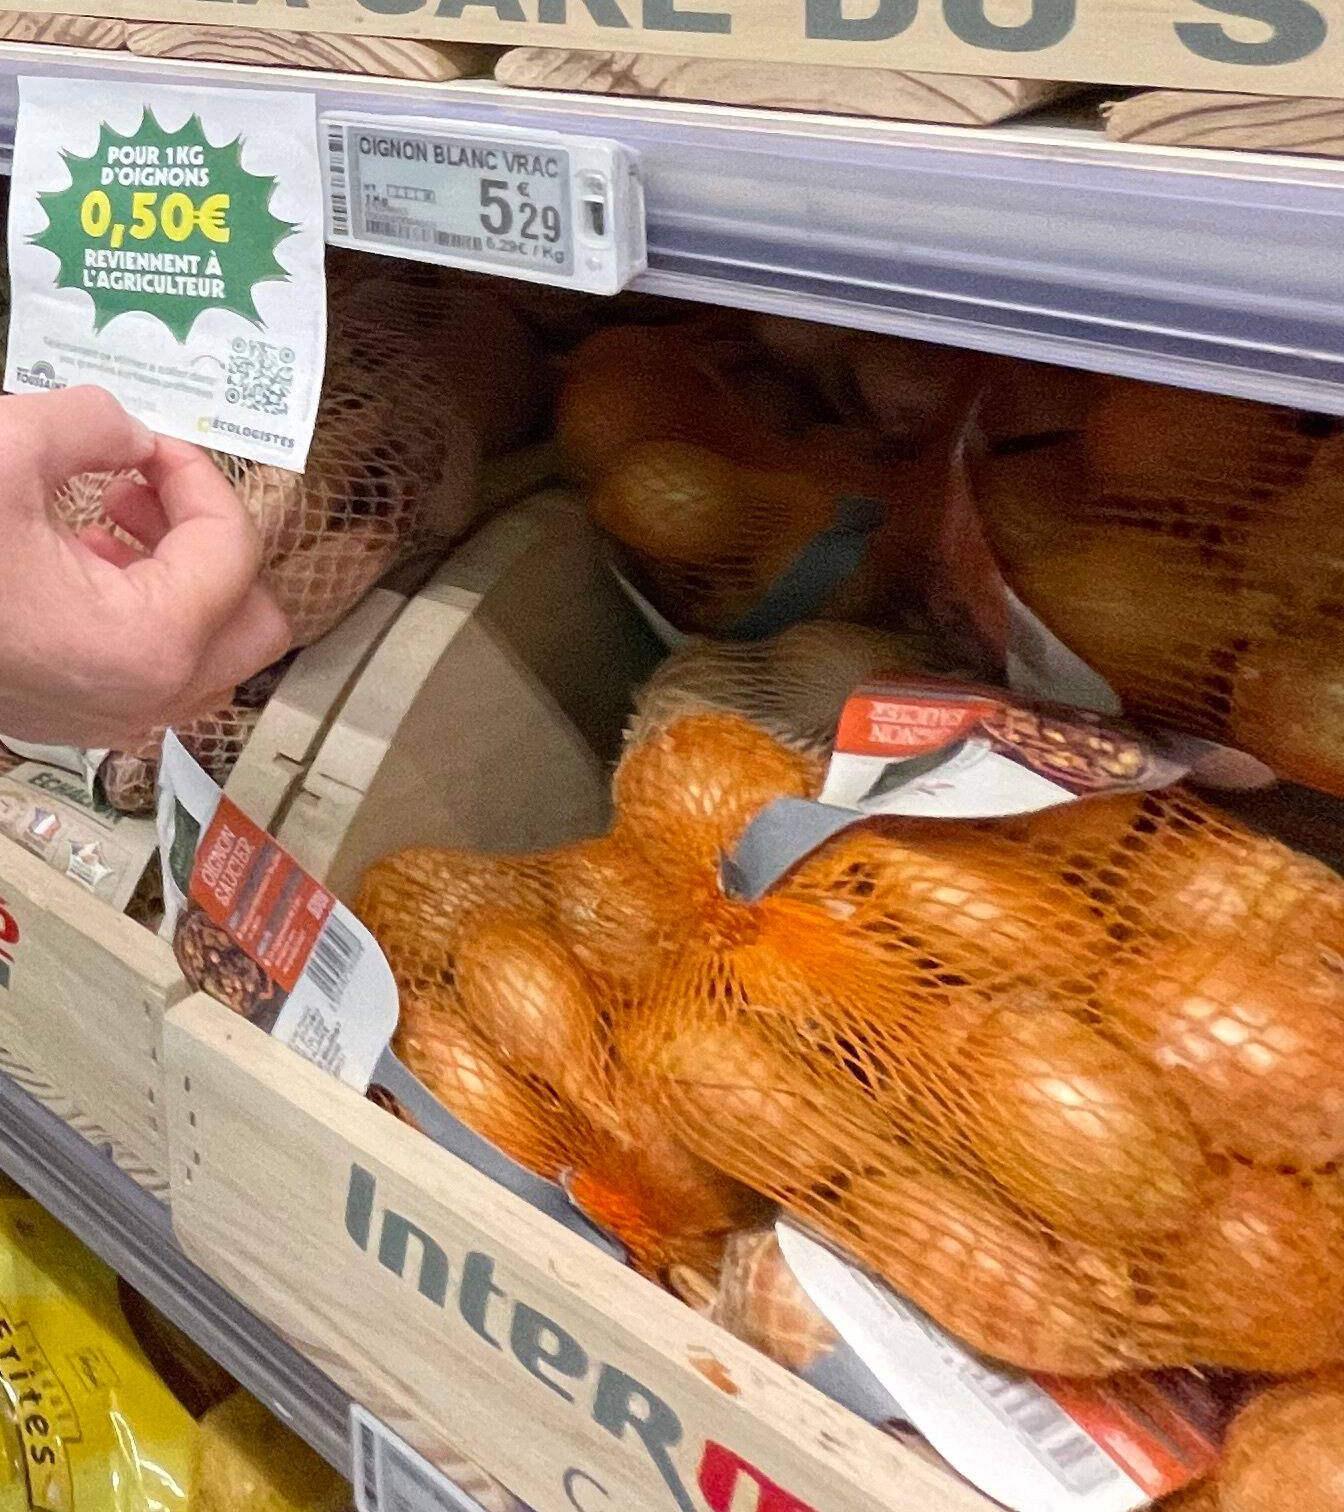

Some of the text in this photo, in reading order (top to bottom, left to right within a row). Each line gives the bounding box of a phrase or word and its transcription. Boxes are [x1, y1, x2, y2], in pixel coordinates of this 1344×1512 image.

[107, 145, 204, 167] POUR 1KG
[359, 136, 559, 178] OIGNON BLANC VRAC
[101, 165, 209, 187] D'OIGNONS
[80, 189, 231, 248] 0,50€
[83, 248, 223, 276] REVIENNENT À
[82, 267, 225, 299] L'AGRICULTEUR
